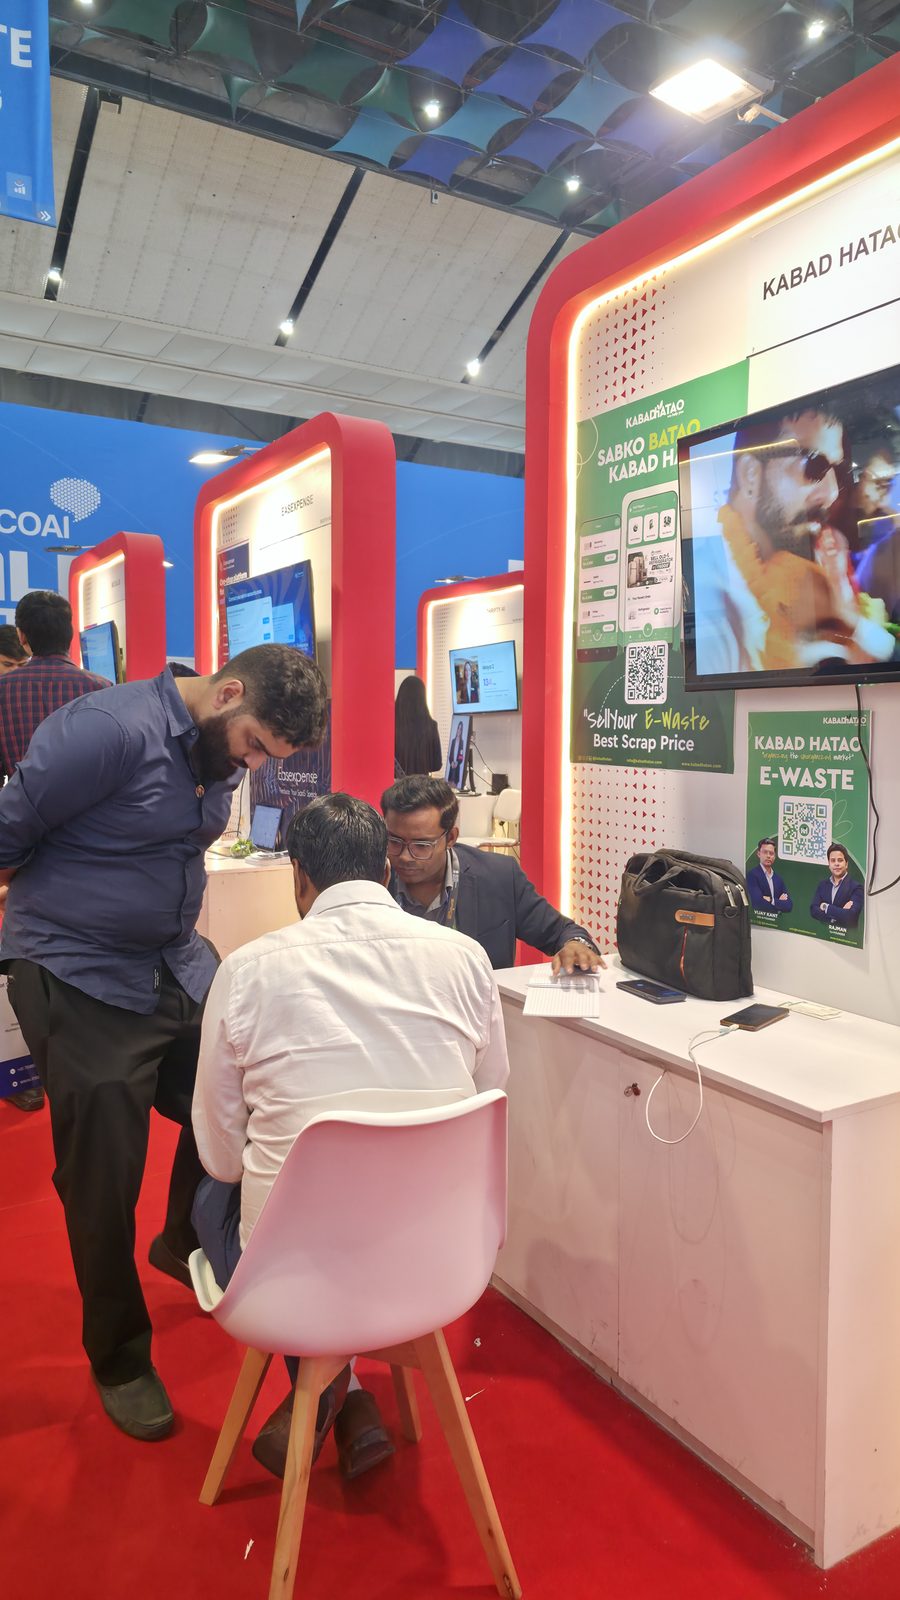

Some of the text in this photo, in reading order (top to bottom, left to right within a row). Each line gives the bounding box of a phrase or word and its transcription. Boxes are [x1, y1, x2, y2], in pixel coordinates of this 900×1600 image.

[763, 224, 900, 300] KABAD HATA
[649, 419, 701, 450] BATAO
[598, 437, 645, 466] SABKO
[609, 448, 679, 484] KABAD H
[281, 494, 314, 517] EASEXPENSE
[0, 509, 70, 539] COAI
[645, 706, 710, 731] E-Waste
[593, 733, 695, 752] Best Scrap Price
[754, 735, 861, 752] KABAD HATAO
[278, 766, 318, 785] Easexpense
[760, 766, 854, 791] E-WASTE
[828, 924, 847, 933] RAJMAN
